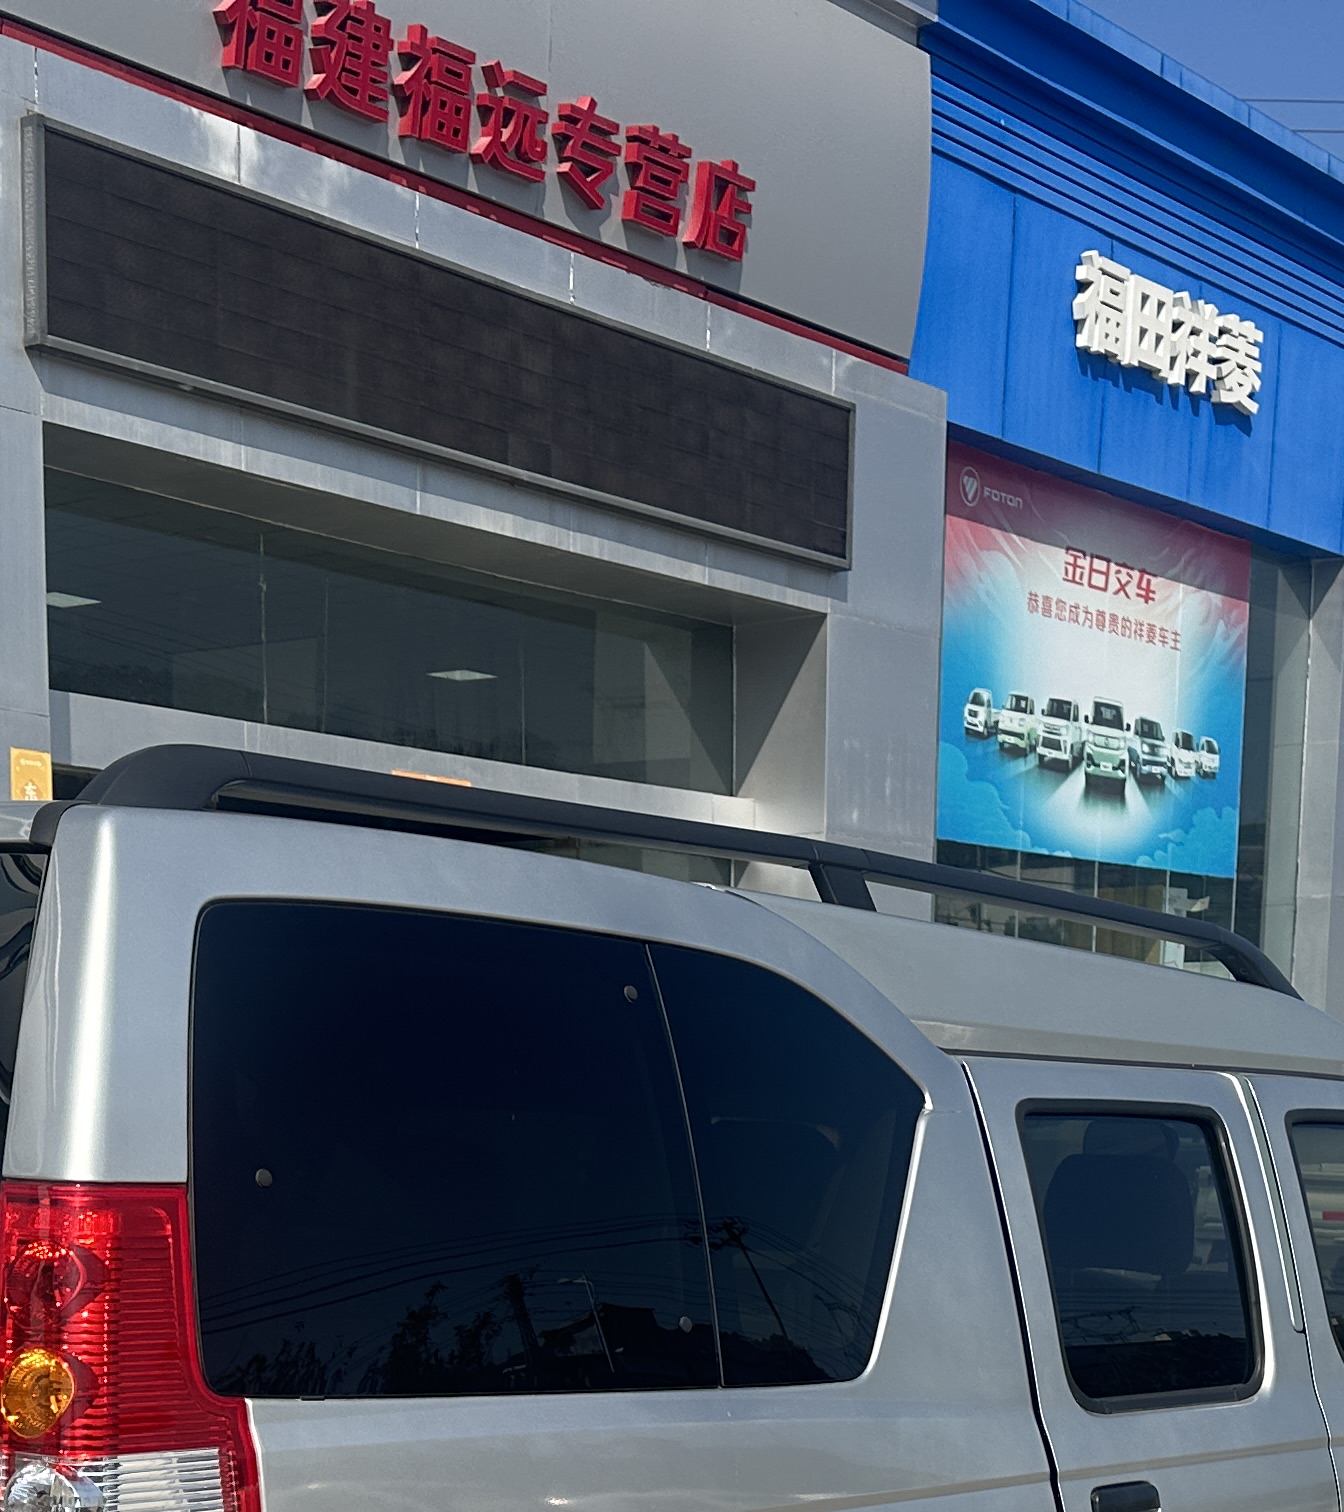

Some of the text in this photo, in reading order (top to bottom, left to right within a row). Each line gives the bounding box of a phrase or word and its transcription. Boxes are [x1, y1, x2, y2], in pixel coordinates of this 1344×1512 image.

[213, 0, 756, 262] 福建福远专营店
[1073, 250, 1264, 415] 福田祥菱
[983, 486, 1023, 510] FOTON
